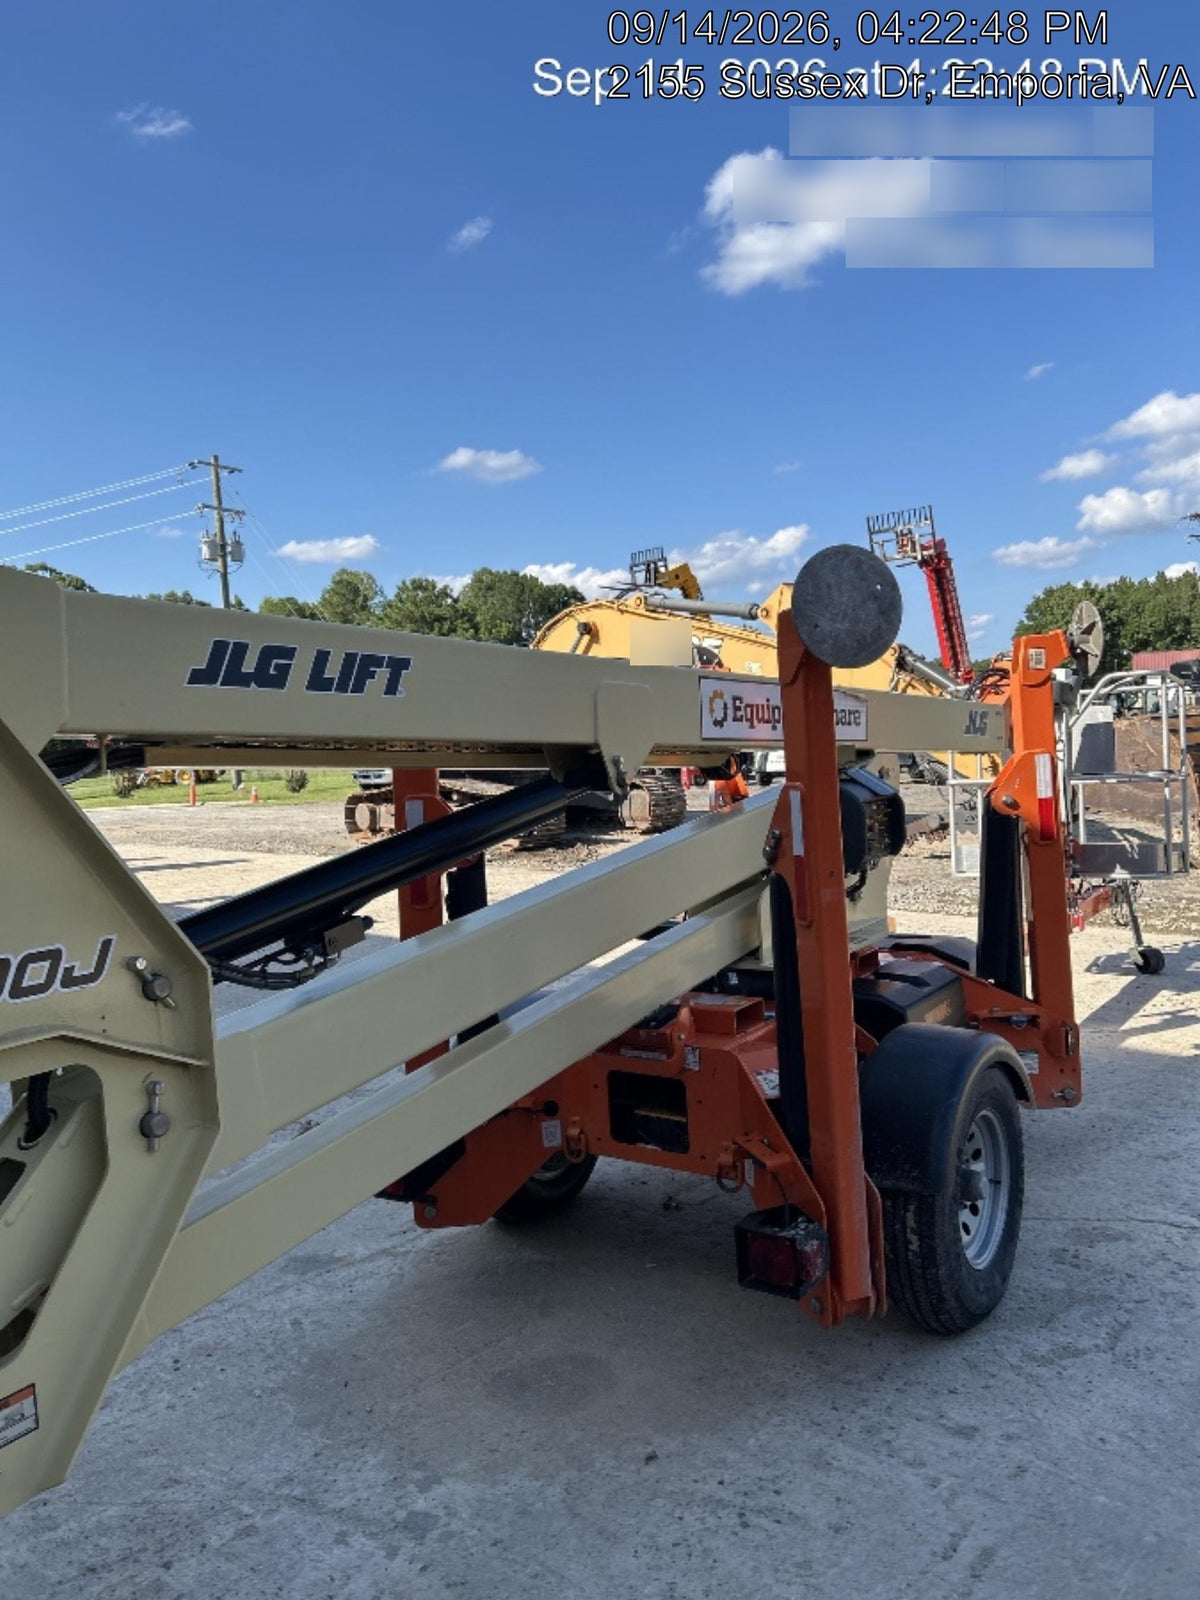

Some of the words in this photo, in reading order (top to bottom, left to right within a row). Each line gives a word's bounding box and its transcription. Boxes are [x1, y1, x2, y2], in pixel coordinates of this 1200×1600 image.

[184, 638, 299, 690] JLG
[304, 647, 412, 697] LIFT
[964, 709, 989, 737] JLG
